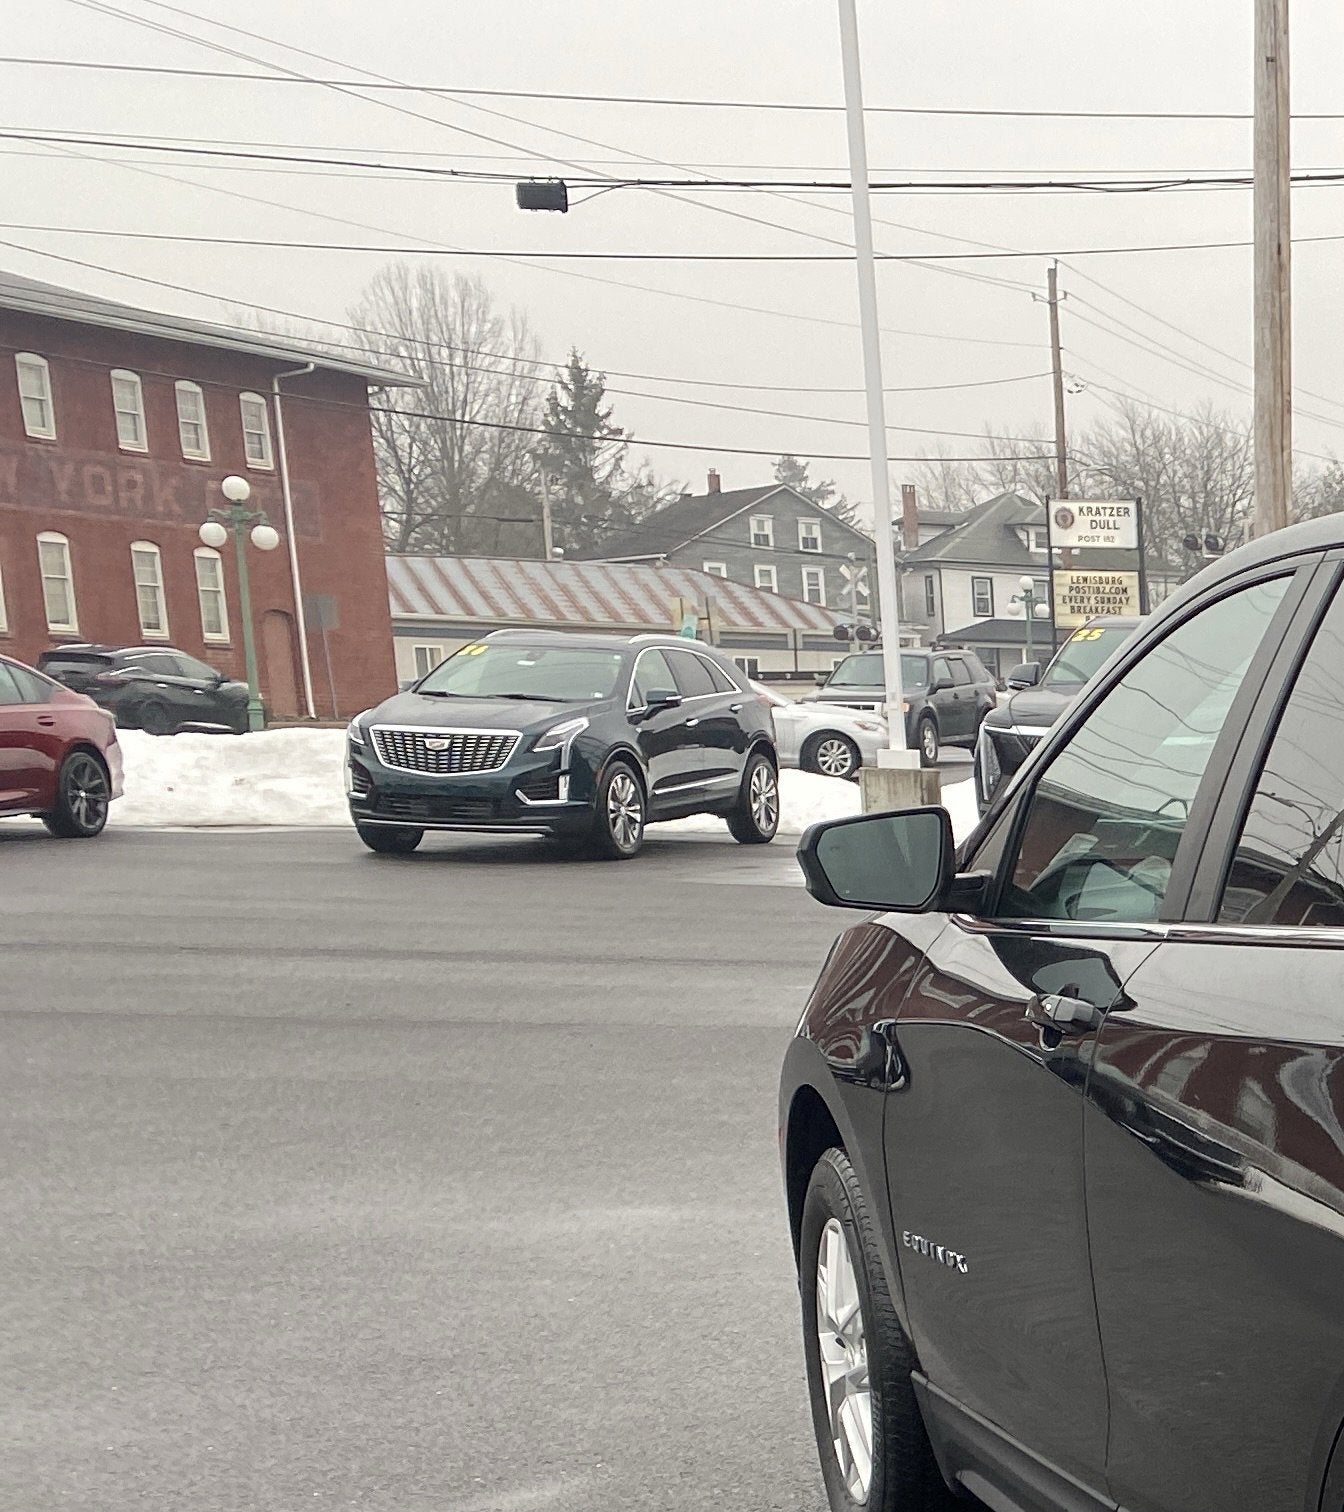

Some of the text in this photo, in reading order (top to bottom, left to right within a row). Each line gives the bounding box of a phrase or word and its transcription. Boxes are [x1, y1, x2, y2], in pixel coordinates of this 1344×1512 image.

[48, 458, 183, 515] YORK
[1078, 506, 1130, 517] KRATZER
[1090, 519, 1120, 530] DULL
[1077, 535, 1101, 543] POST
[1071, 576, 1123, 585] LEWISBURG
[1062, 595, 1130, 605] EVERY SUNDAY
[1070, 605, 1122, 615] BREAKFAST
